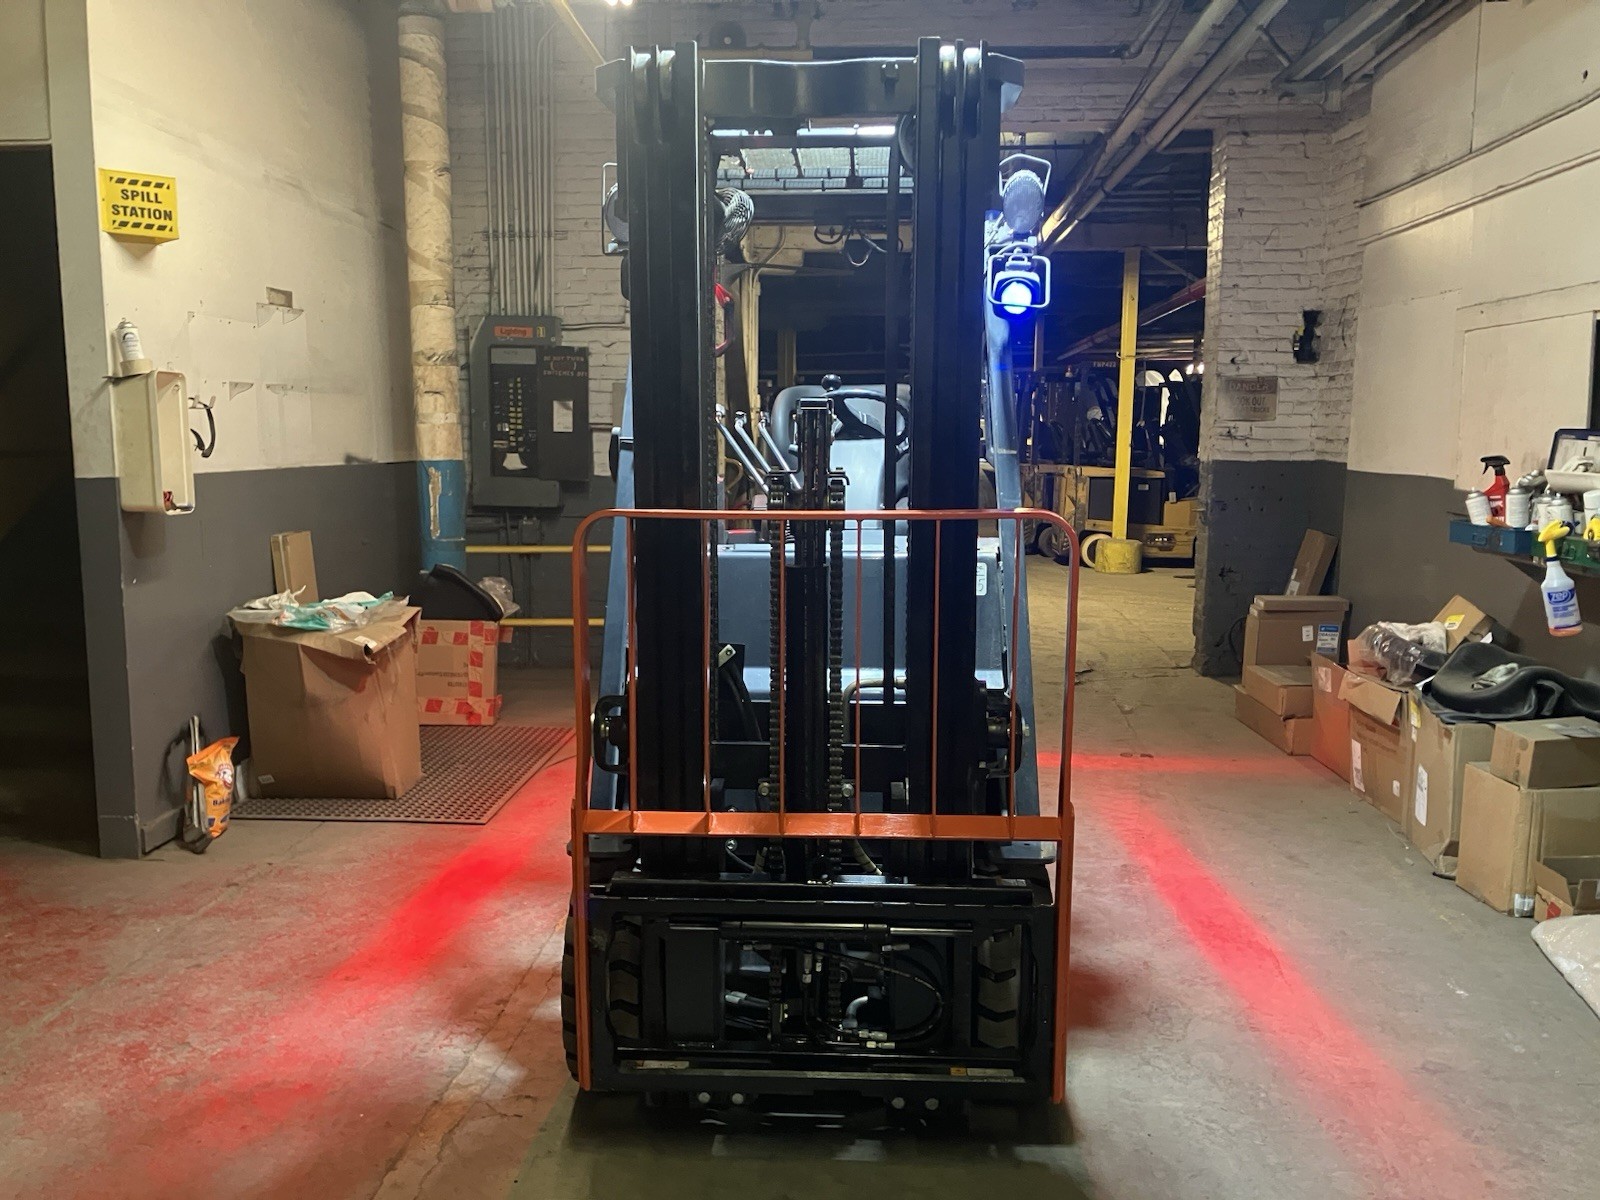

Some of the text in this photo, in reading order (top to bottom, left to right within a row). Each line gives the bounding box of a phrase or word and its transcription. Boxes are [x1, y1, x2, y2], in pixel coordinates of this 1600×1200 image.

[121, 189, 163, 204] SPILL
[111, 204, 173, 221] STATION
[500, 327, 527, 337] Lighting
[1229, 381, 1270, 391] DANGER
[1252, 396, 1266, 406] OUT
